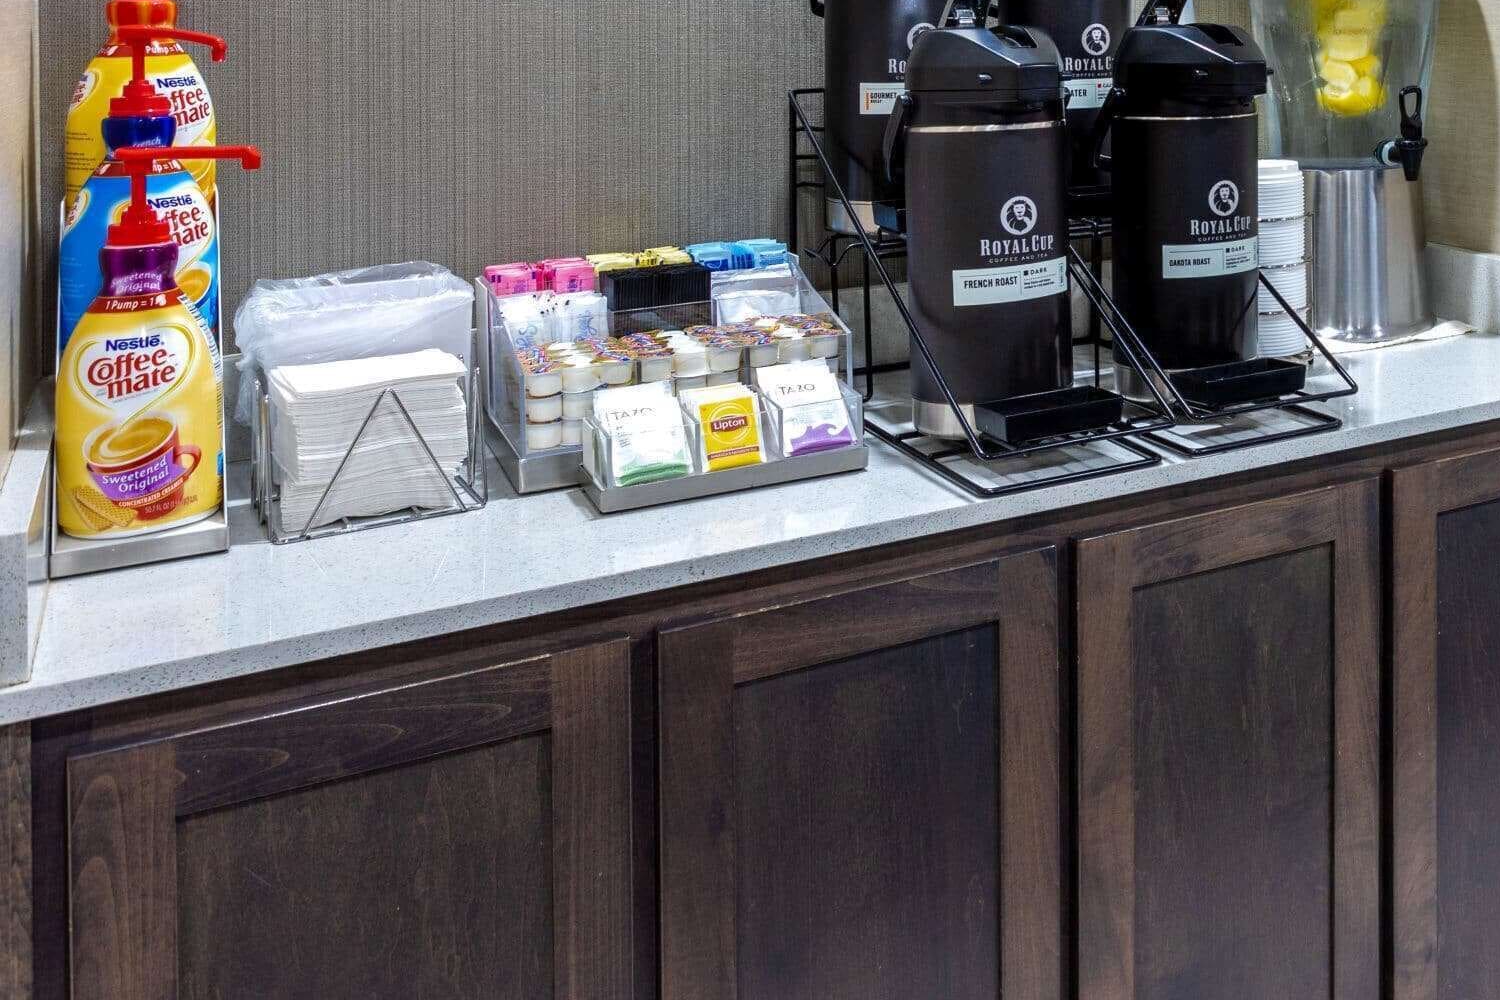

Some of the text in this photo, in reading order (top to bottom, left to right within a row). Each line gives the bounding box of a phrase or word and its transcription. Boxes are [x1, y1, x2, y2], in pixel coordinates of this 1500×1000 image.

[1065, 56, 1104, 72] ROYAL
[1069, 89, 1087, 98] ATER
[1190, 215, 1251, 235] ROYAL CUP
[980, 234, 1054, 257] ROYAL CUP
[988, 256, 1019, 264] COFFEE
[1169, 257, 1211, 267] DAKOTA ROAST
[963, 278, 994, 290] FRENCH
[995, 276, 1018, 287] ROAST
[111, 299, 139, 311] Pump
[105, 335, 161, 352] Nestlé
[107, 364, 176, 400] mate
[713, 418, 746, 431] Lipton
[101, 455, 168, 485] Sweetened
[118, 466, 170, 493] Original
[118, 492, 161, 508] CONCENTRATED
